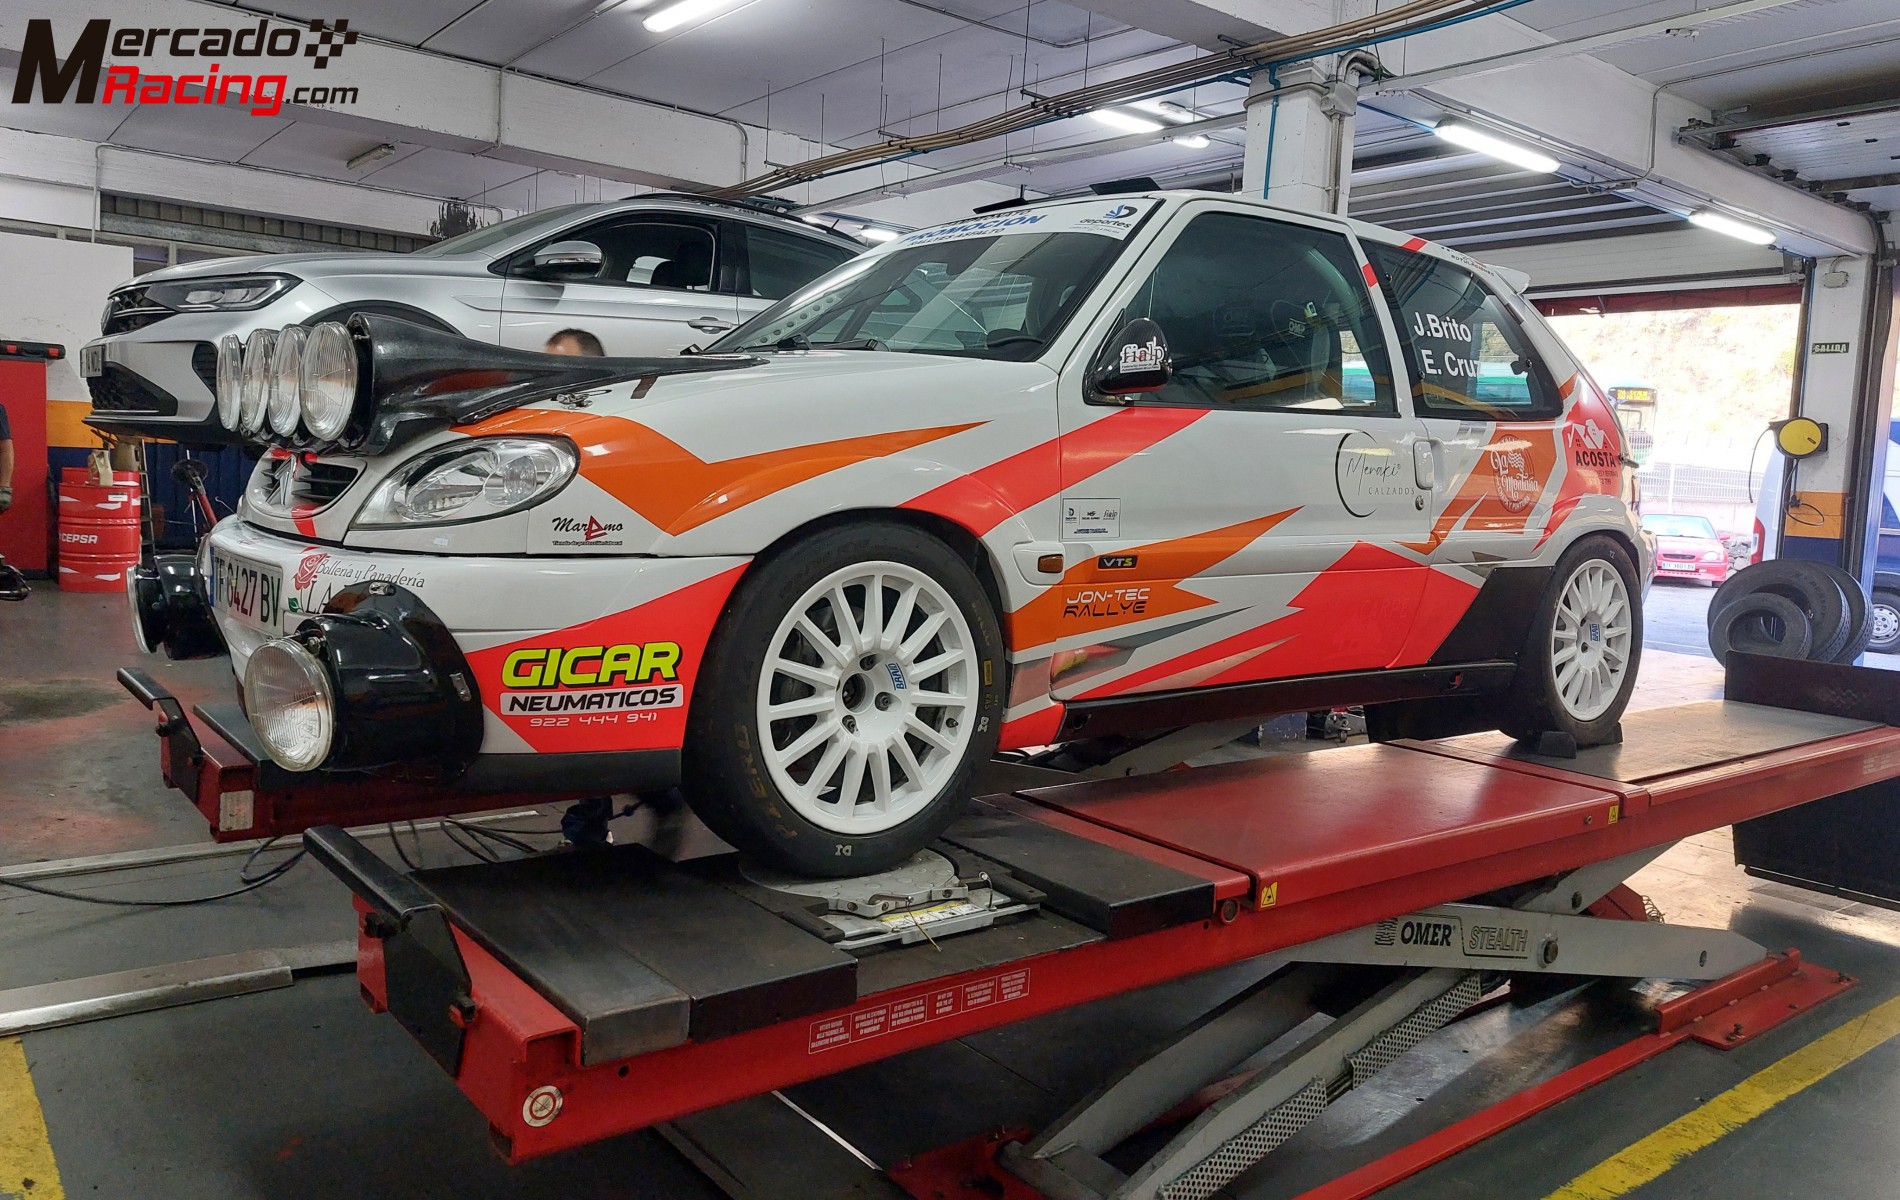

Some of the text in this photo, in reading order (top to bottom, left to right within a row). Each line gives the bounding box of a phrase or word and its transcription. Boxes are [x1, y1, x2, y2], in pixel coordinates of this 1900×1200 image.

[1079, 218, 1132, 229] deportes
[1414, 312, 1472, 343] J.Brito
[1421, 349, 1442, 375] E.
[1575, 450, 1617, 468] ACOSTA
[1368, 486, 1415, 496] CALZADOS
[61, 532, 98, 544] CEPSA
[1102, 558, 1133, 567] VTS
[355, 570, 363, 583] y
[260, 573, 281, 627] BV
[1066, 587, 1151, 605] JON-TEC
[1063, 600, 1147, 619] RALLYE
[501, 641, 683, 690] GICAR
[888, 662, 906, 690] BRAID
[508, 686, 678, 713] NEUMATICOS
[530, 712, 657, 727] 922 444 941
[1401, 921, 1451, 946] OMER
[1469, 926, 1529, 951] STEALTH
